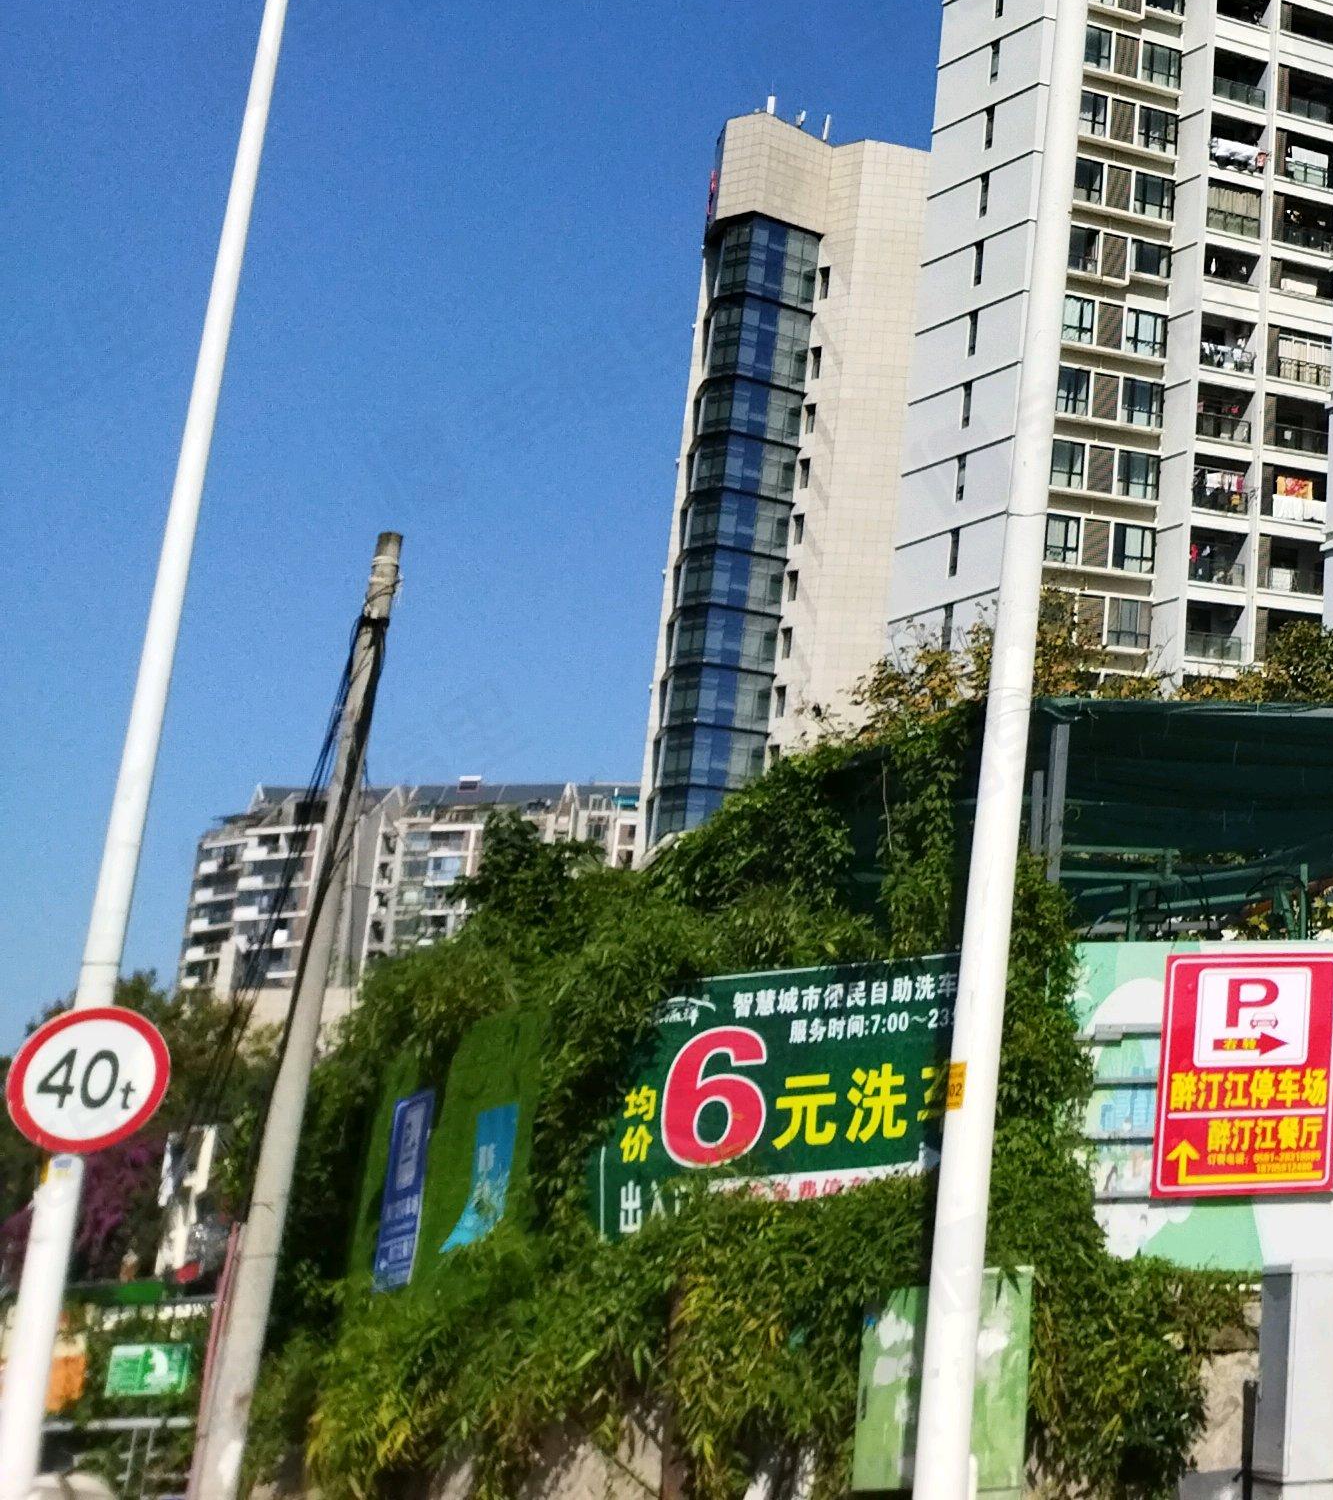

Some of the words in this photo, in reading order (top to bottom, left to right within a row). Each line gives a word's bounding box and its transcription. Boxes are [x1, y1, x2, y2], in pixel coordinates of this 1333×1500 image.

[1225, 977, 1280, 1029] P
[1169, 1067, 1329, 1112] 醉汀江停车场
[619, 1084, 657, 1164] 均价
[1206, 1115, 1323, 1153] 醉汀江餐厅
